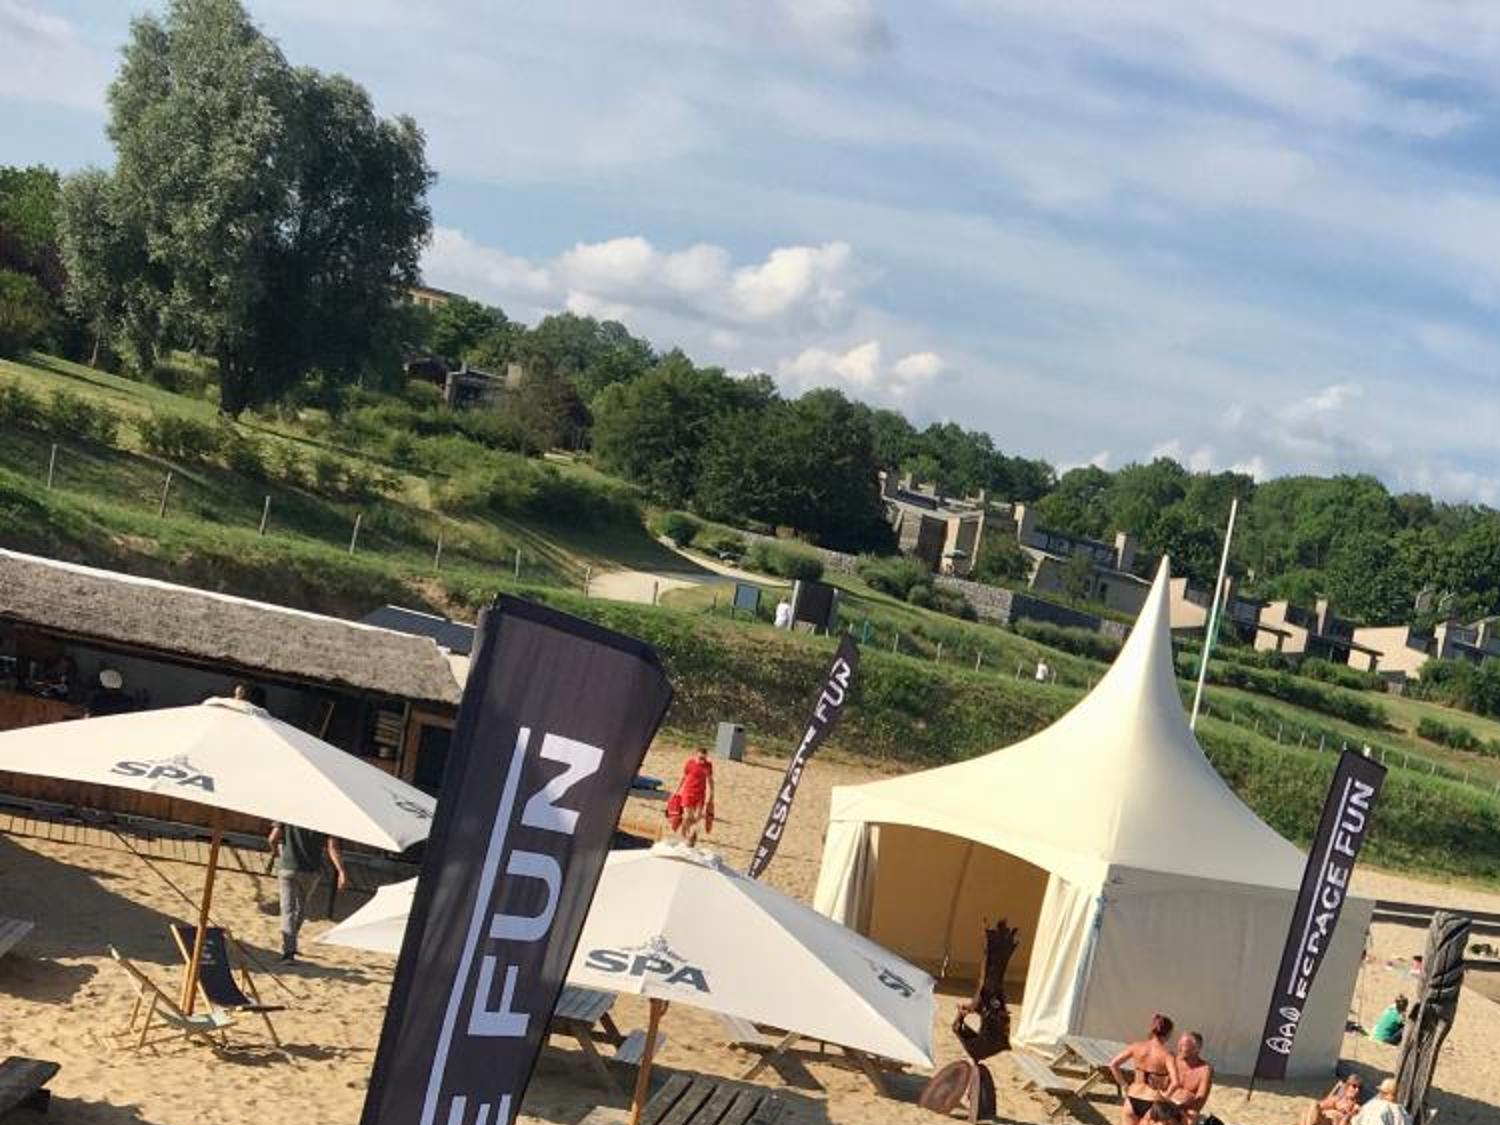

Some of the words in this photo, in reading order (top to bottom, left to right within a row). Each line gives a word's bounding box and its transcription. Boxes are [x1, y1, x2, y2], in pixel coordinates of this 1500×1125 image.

[814, 656, 851, 724] FUN
[111, 760, 216, 793] SPA
[468, 733, 604, 1037] FUN
[1295, 861, 1350, 999] ESPACE
[1334, 780, 1376, 857] FUN
[584, 948, 712, 993] SPA
